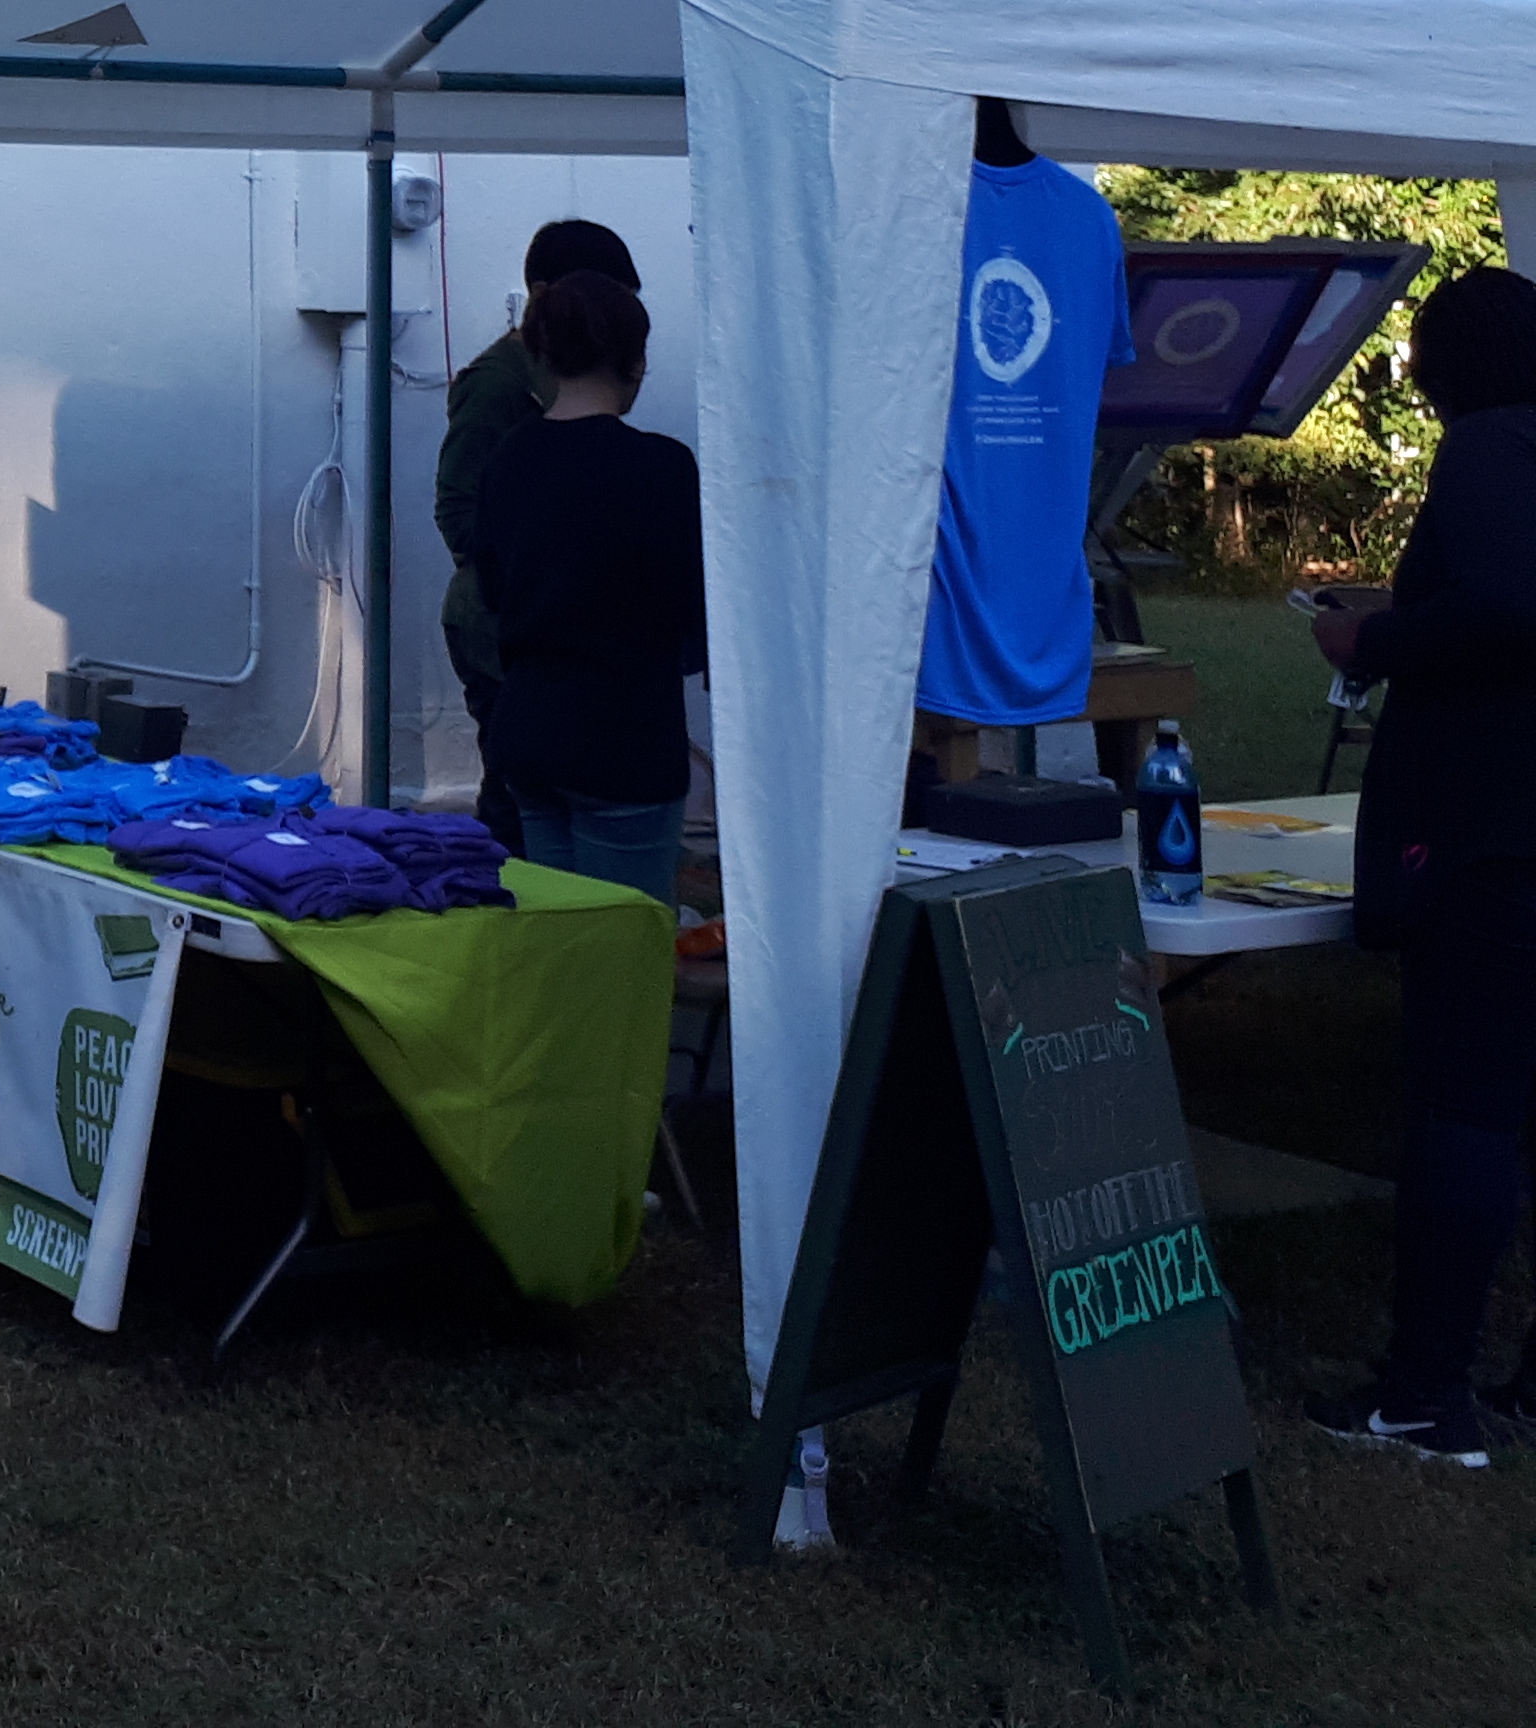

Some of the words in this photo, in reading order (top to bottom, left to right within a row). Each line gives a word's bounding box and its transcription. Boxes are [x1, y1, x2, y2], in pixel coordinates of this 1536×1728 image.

[75, 1025, 134, 1078] PEAC
[1020, 1015, 1137, 1080] PRINTING
[75, 1070, 122, 1121] LOV
[6, 1204, 89, 1278] SCREENP
[1029, 1188, 1088, 1260] HOT
[1091, 1173, 1138, 1240] OFF
[1047, 1224, 1222, 1354] GREENPEA
